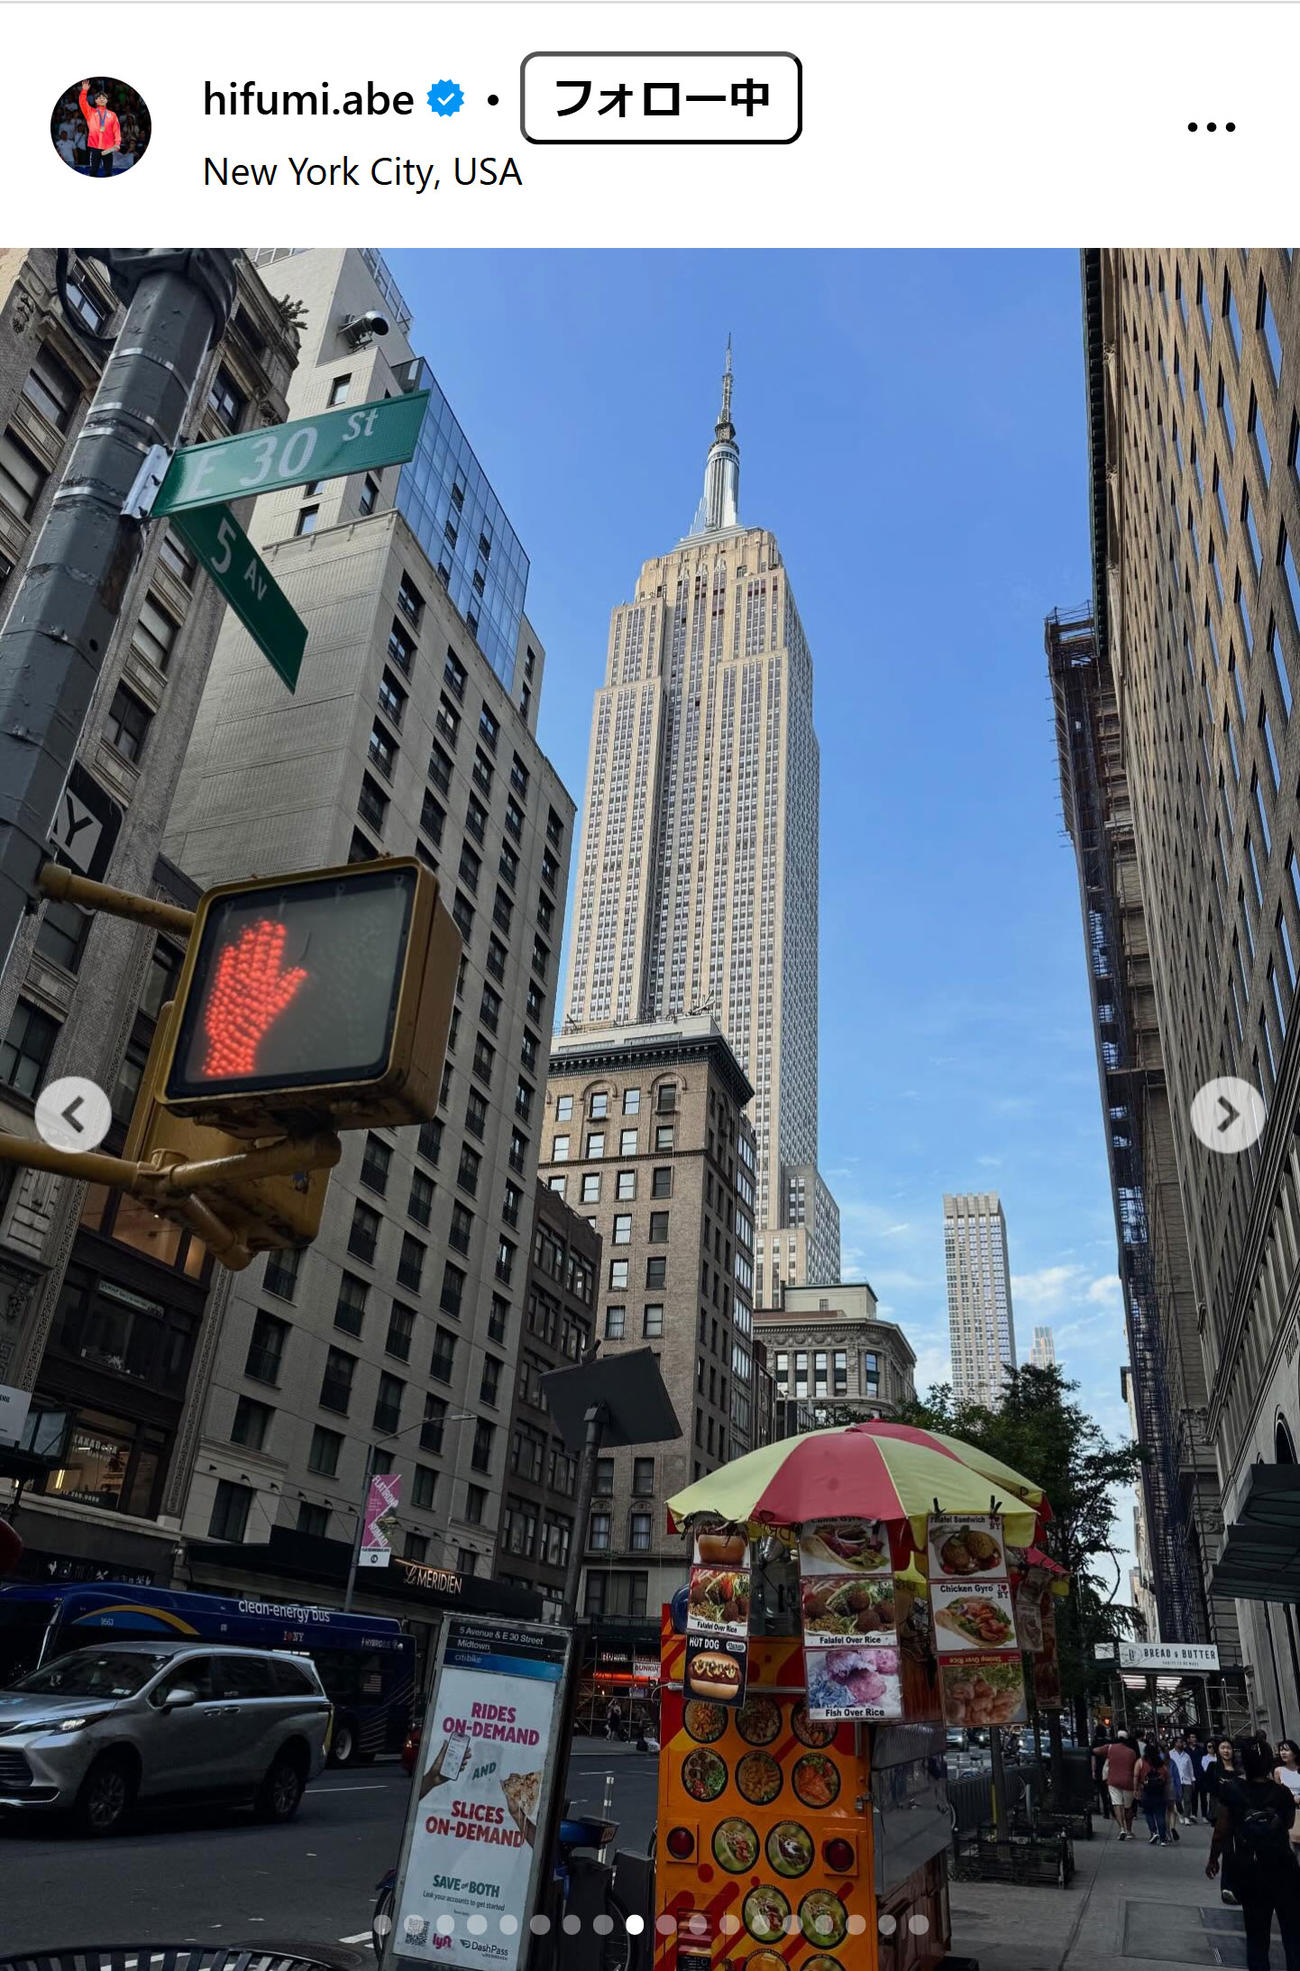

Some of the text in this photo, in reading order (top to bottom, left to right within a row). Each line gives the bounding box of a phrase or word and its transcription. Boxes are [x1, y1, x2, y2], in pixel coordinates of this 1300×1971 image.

[180, 407, 379, 497] E 30 St
[211, 517, 268, 602] 5 Av
[940, 1584, 993, 1594] Chicken Gyro
[238, 1599, 331, 1623] clean-energy bus
[459, 1626, 544, 1645] 5 Avenue & E 30 Street
[714, 1623, 725, 1631] Over
[726, 1625, 738, 1634] Rice
[457, 1639, 490, 1650] Midtown
[689, 1636, 703, 1649] HOT
[704, 1638, 720, 1650] DOG
[819, 1635, 881, 1644] Falafel Over Rice
[1144, 1648, 1171, 1658] BREAD
[1181, 1649, 1216, 1659] BUTTER
[471, 1702, 517, 1724] RIDES
[825, 1708, 885, 1717] Fish Over Rice
[442, 1717, 540, 1746] ON-DEMAND
[472, 1762, 497, 1781] AND
[451, 1800, 505, 1825] SLICES
[425, 1816, 525, 1849] ON-DEMAND
[432, 1874, 461, 1891] SAVE
[468, 1880, 501, 1898] BOTH
[432, 1892, 446, 1902] your
[446, 1894, 470, 1905] accounts
[476, 1900, 486, 1909] get
[486, 1901, 505, 1912] started
[432, 1934, 452, 1950] lyft
[471, 1941, 509, 1956] DashPass
